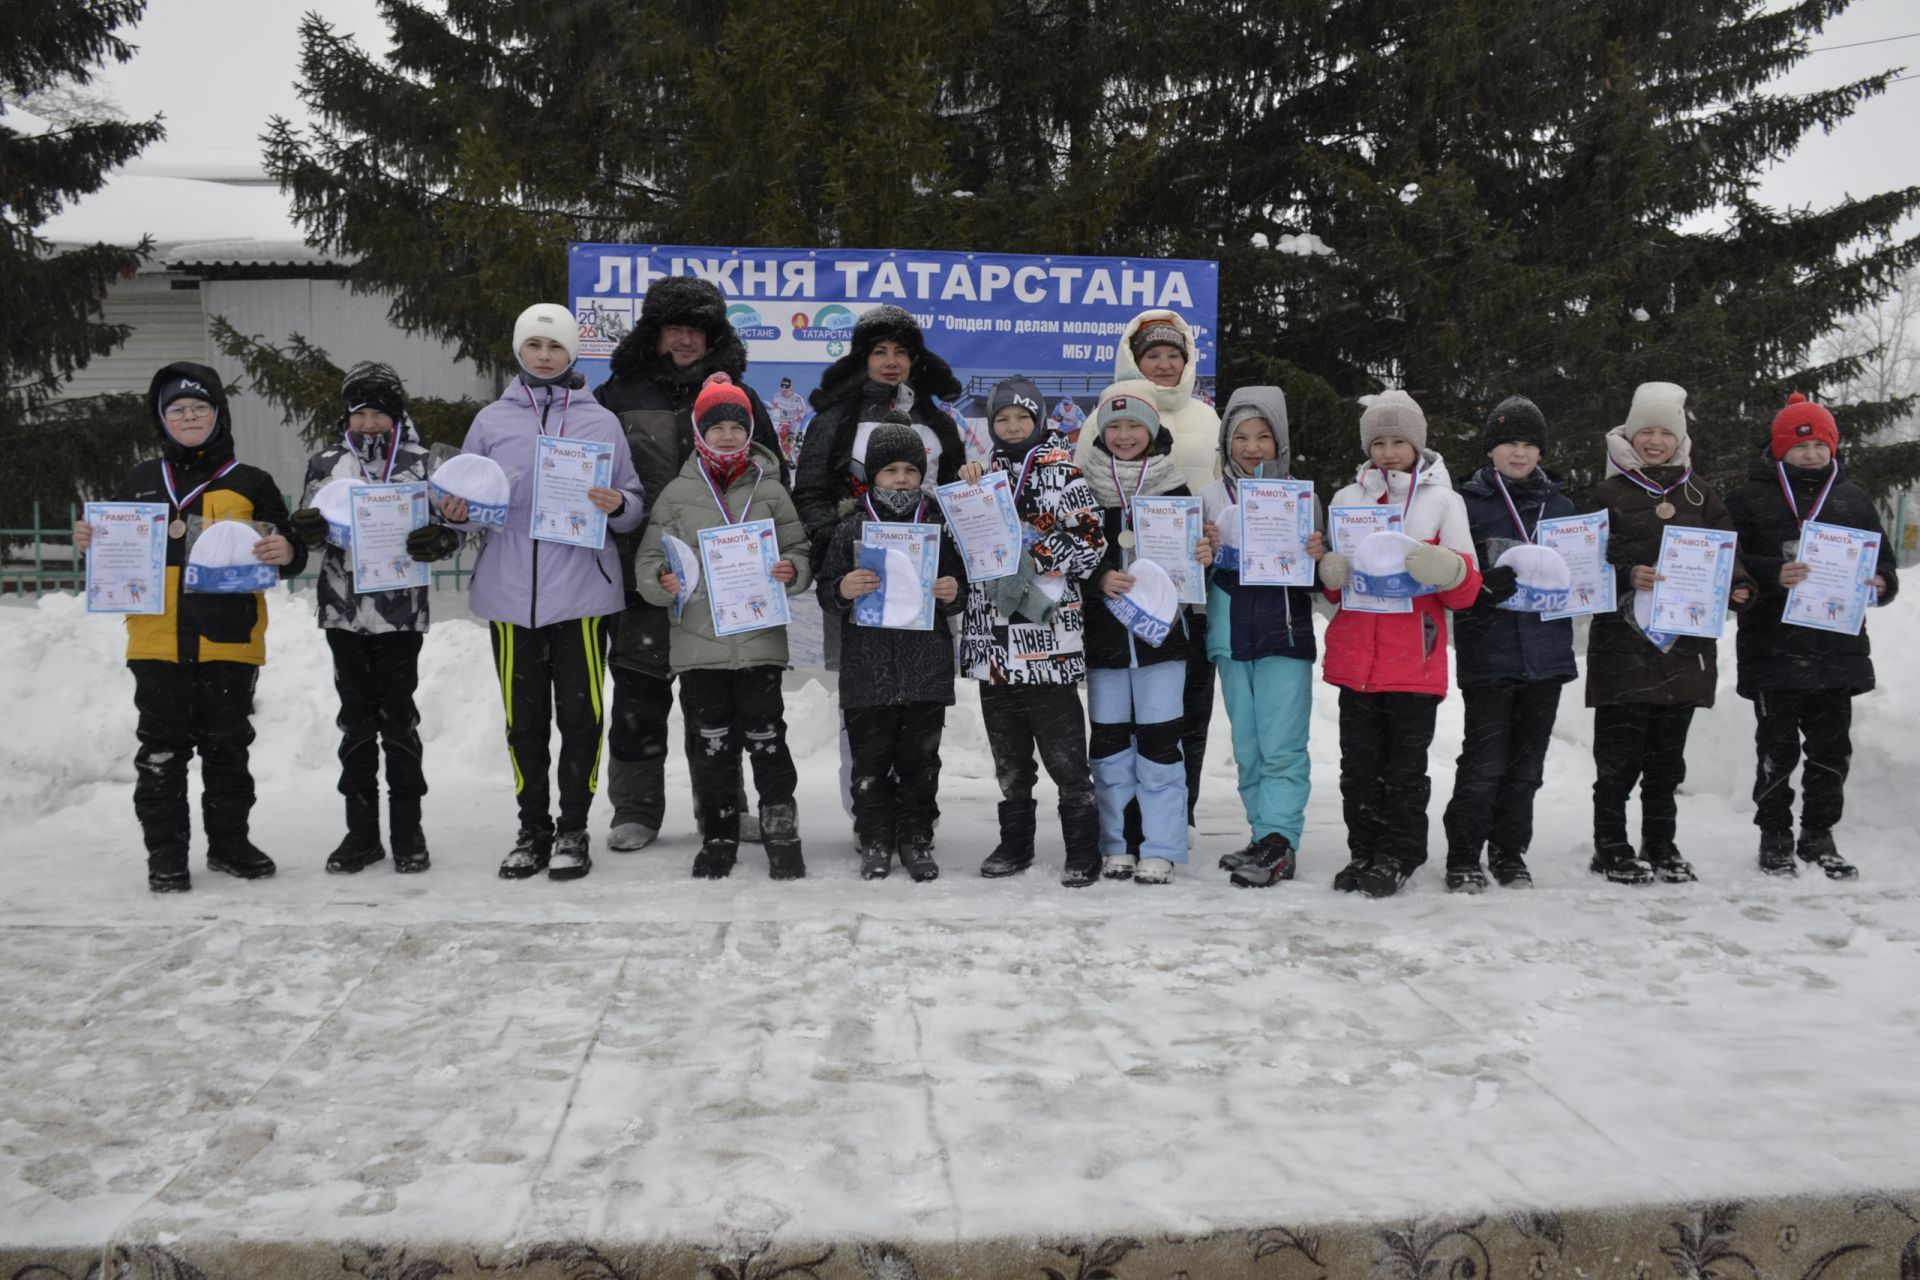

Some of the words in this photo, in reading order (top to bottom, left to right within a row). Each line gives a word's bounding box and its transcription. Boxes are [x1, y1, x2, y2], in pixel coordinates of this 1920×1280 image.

[835, 261, 1193, 307] ТАТАРСТАНА
[995, 319, 1011, 332] по
[1014, 319, 1059, 334] делам
[1063, 320, 1126, 336] молодеж
[1062, 344, 1092, 360] МБУ
[1094, 344, 1114, 362] ДО
[949, 487, 985, 502] ГРАМОТА
[1251, 489, 1288, 498] ГРАМОТА
[1143, 507, 1178, 515] ГРАМОТА
[1341, 516, 1378, 525] ГРАМОТА
[875, 532, 914, 541] ГРАМОТА
[1550, 525, 1589, 537] ГРАМОТА
[712, 534, 750, 546] ГРАМОТА
[1673, 537, 1710, 548] ГРАМОТА
[1813, 531, 1853, 545] ГРАМОТА
